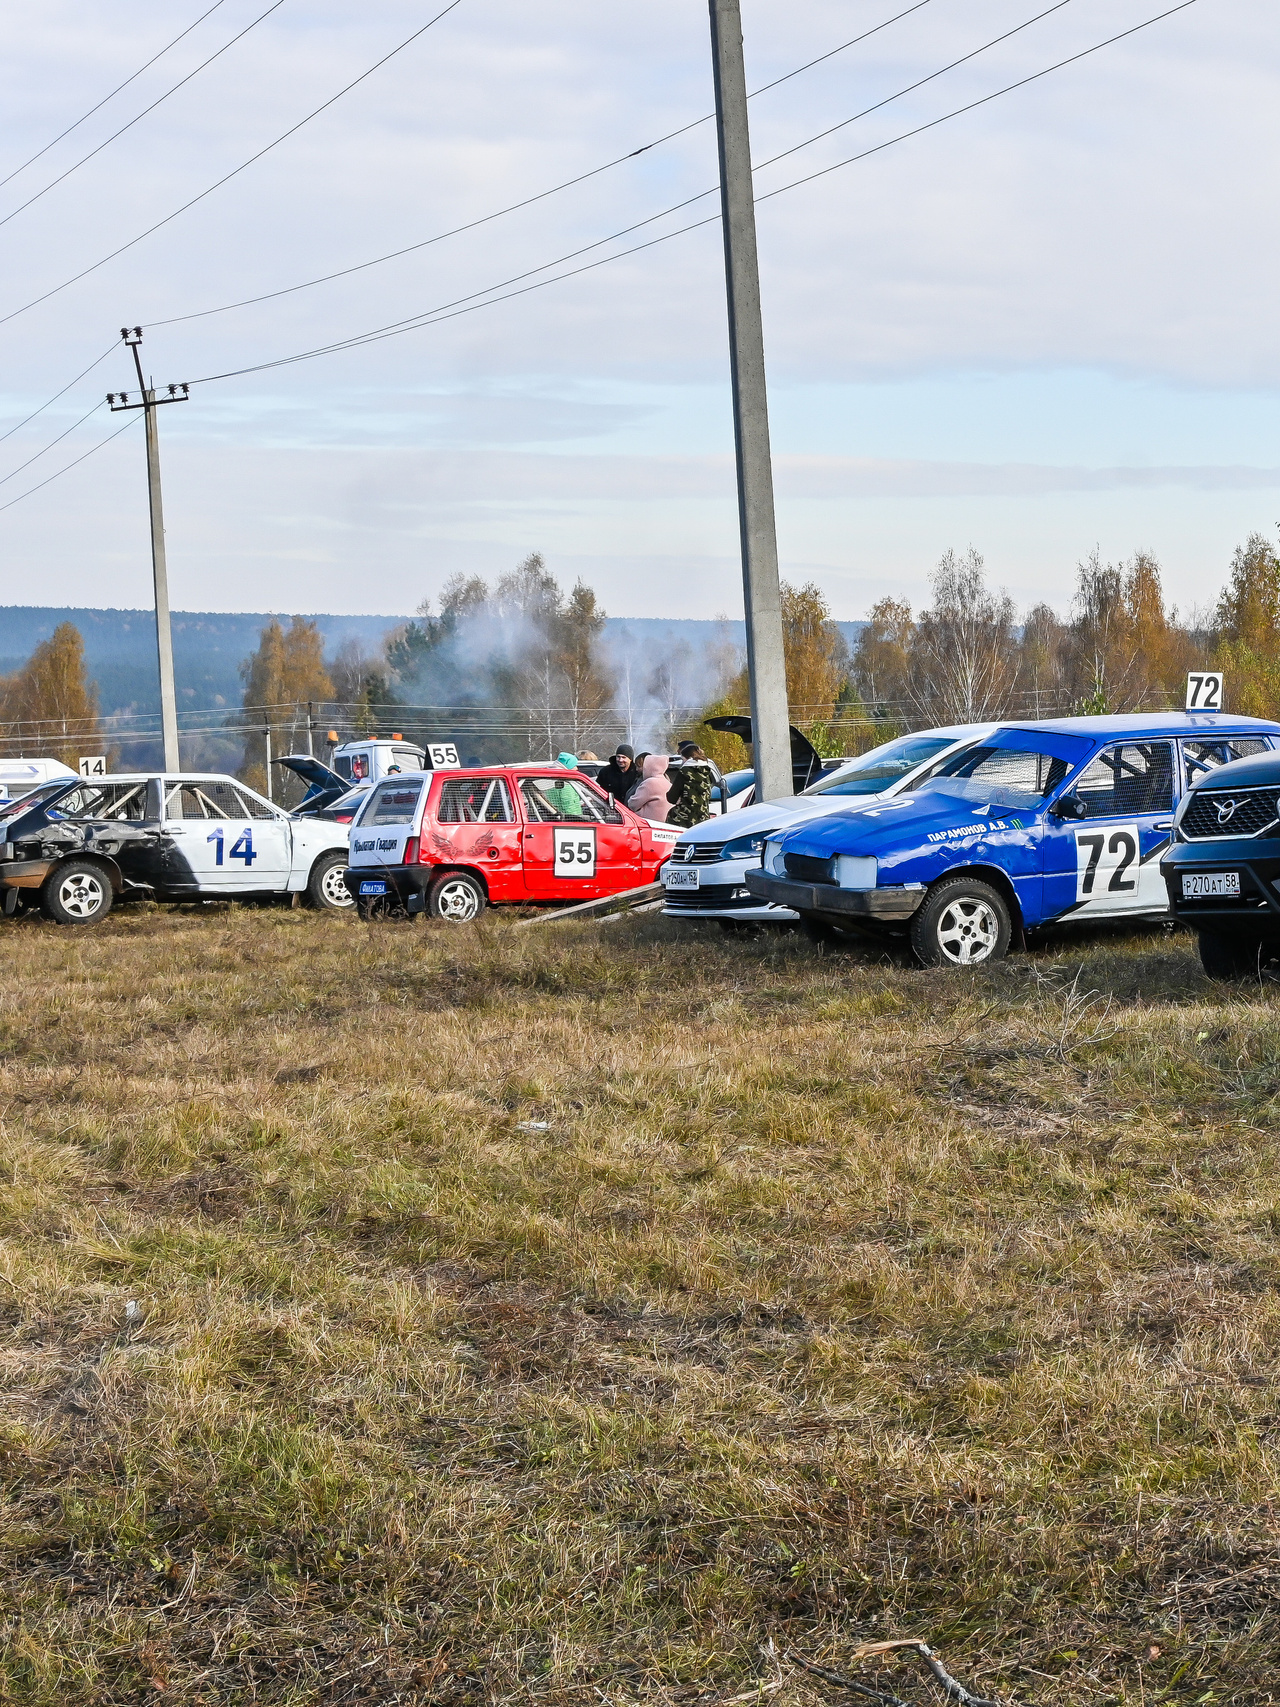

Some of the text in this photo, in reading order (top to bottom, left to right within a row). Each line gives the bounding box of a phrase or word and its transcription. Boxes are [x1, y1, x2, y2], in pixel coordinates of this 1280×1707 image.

[1189, 676, 1220, 707] 72
[432, 747, 458, 765] 55
[81, 759, 105, 776] 14
[927, 820, 1010, 843] ПАРАМОНОВ А.В.
[206, 827, 257, 866] 14
[559, 842, 592, 864] 55
[1078, 832, 1136, 893] 72
[1225, 874, 1237, 888] 58
